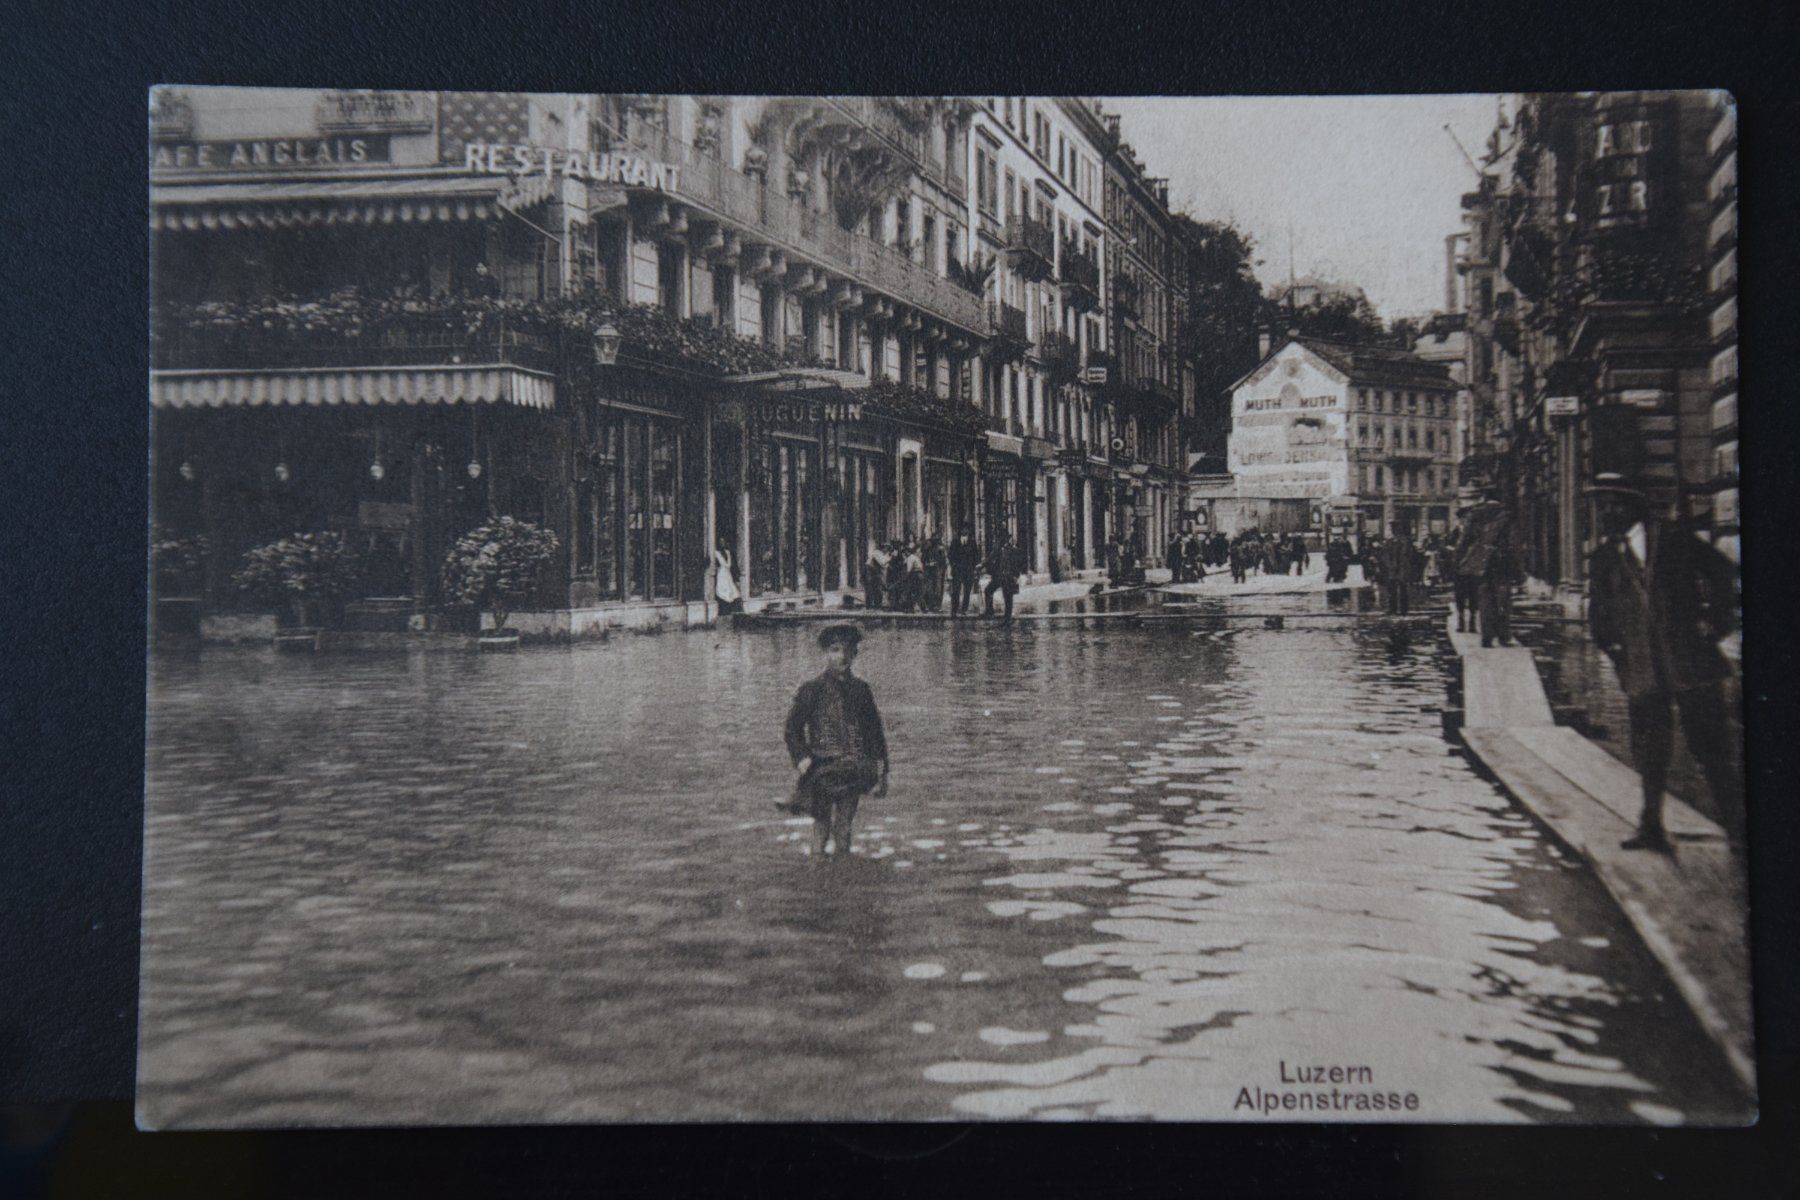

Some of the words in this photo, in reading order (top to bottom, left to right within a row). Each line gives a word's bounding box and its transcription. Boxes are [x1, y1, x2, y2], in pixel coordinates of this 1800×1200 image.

[230, 139, 368, 164] ANGLAIS
[465, 142, 681, 192] RESTAURANT
[748, 402, 861, 422] UGUENIN
[1246, 398, 1281, 410] MUTH
[1300, 395, 1336, 408] MUTH
[1280, 1060, 1373, 1083] Luzern
[1234, 1086, 1420, 1116] Alpenstrasse
